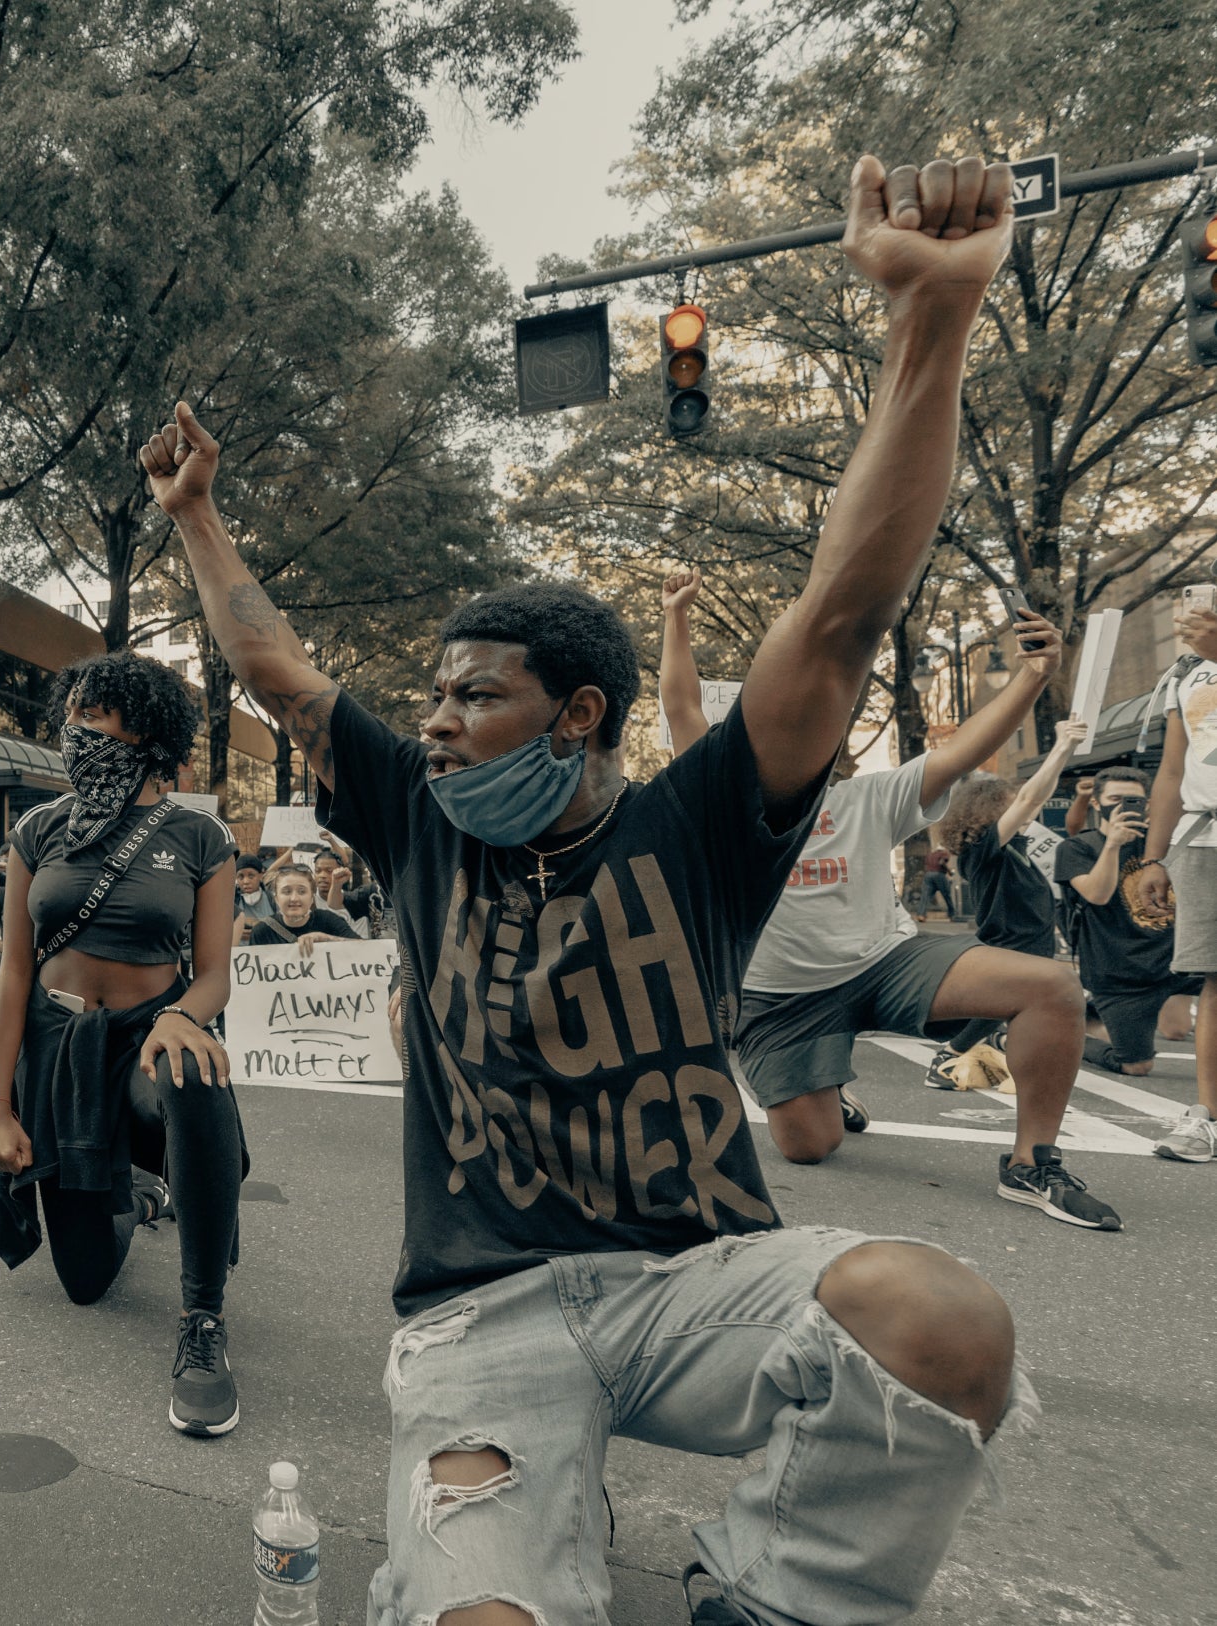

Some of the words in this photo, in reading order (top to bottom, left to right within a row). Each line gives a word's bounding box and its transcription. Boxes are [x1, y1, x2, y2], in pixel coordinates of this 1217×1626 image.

[152, 862, 174, 871] adidas
[47, 921, 79, 953] GUESS
[78, 871, 116, 919] GUESS
[233, 953, 317, 985] Black
[326, 951, 395, 981] Lives
[268, 989, 375, 1027] ALWAYS
[437, 1064, 775, 1230] POWER
